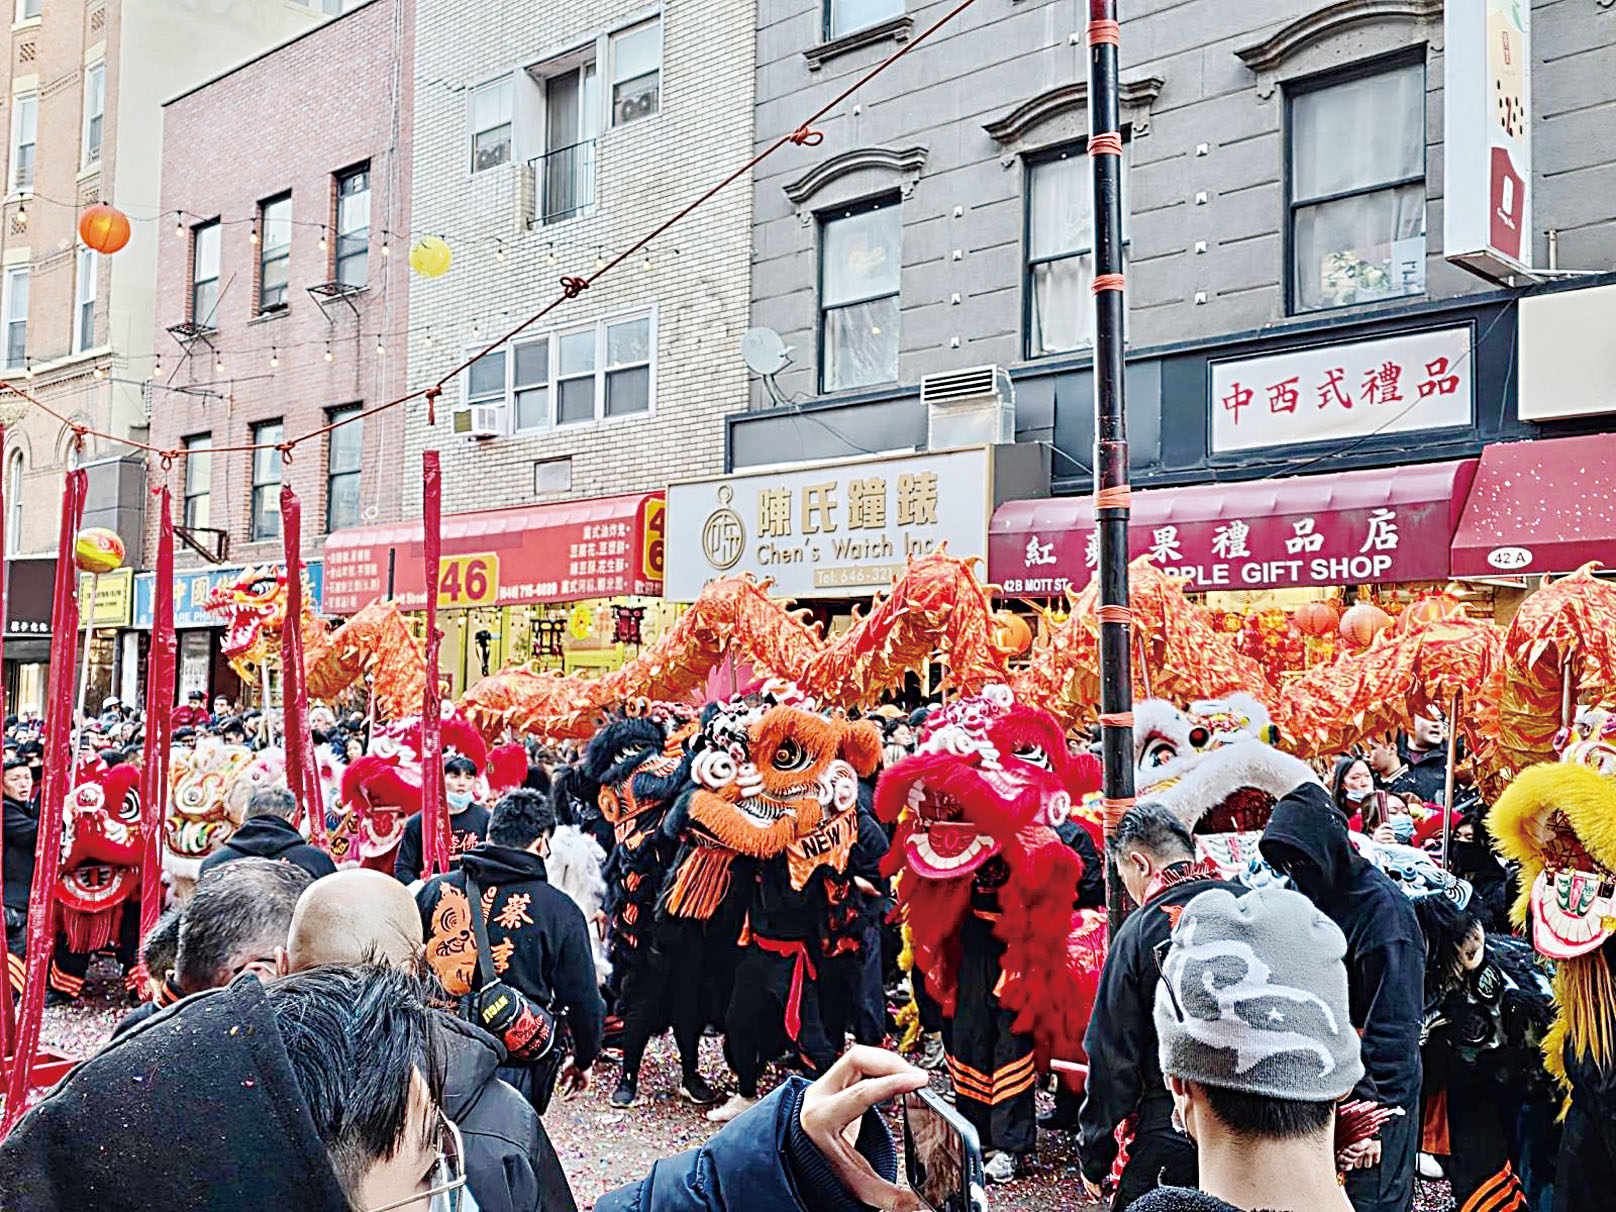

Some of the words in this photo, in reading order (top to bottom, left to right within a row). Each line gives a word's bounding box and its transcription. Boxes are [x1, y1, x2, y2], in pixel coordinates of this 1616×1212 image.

[1222, 357, 1459, 425] 中西式禮品
[757, 471, 938, 538] 陳氏鐘錶
[757, 537, 820, 566] Chen's
[832, 533, 893, 560] Watch
[1494, 552, 1511, 564] 42
[1515, 551, 1526, 563] A
[440, 560, 487, 601] 46
[1003, 578, 1023, 592] 42B
[1025, 577, 1053, 592] MOTT
[1163, 564, 1230, 585] PPLE
[1241, 560, 1303, 584] GIFT
[1310, 554, 1392, 581] SHOP
[800, 823, 841, 860] NEW
